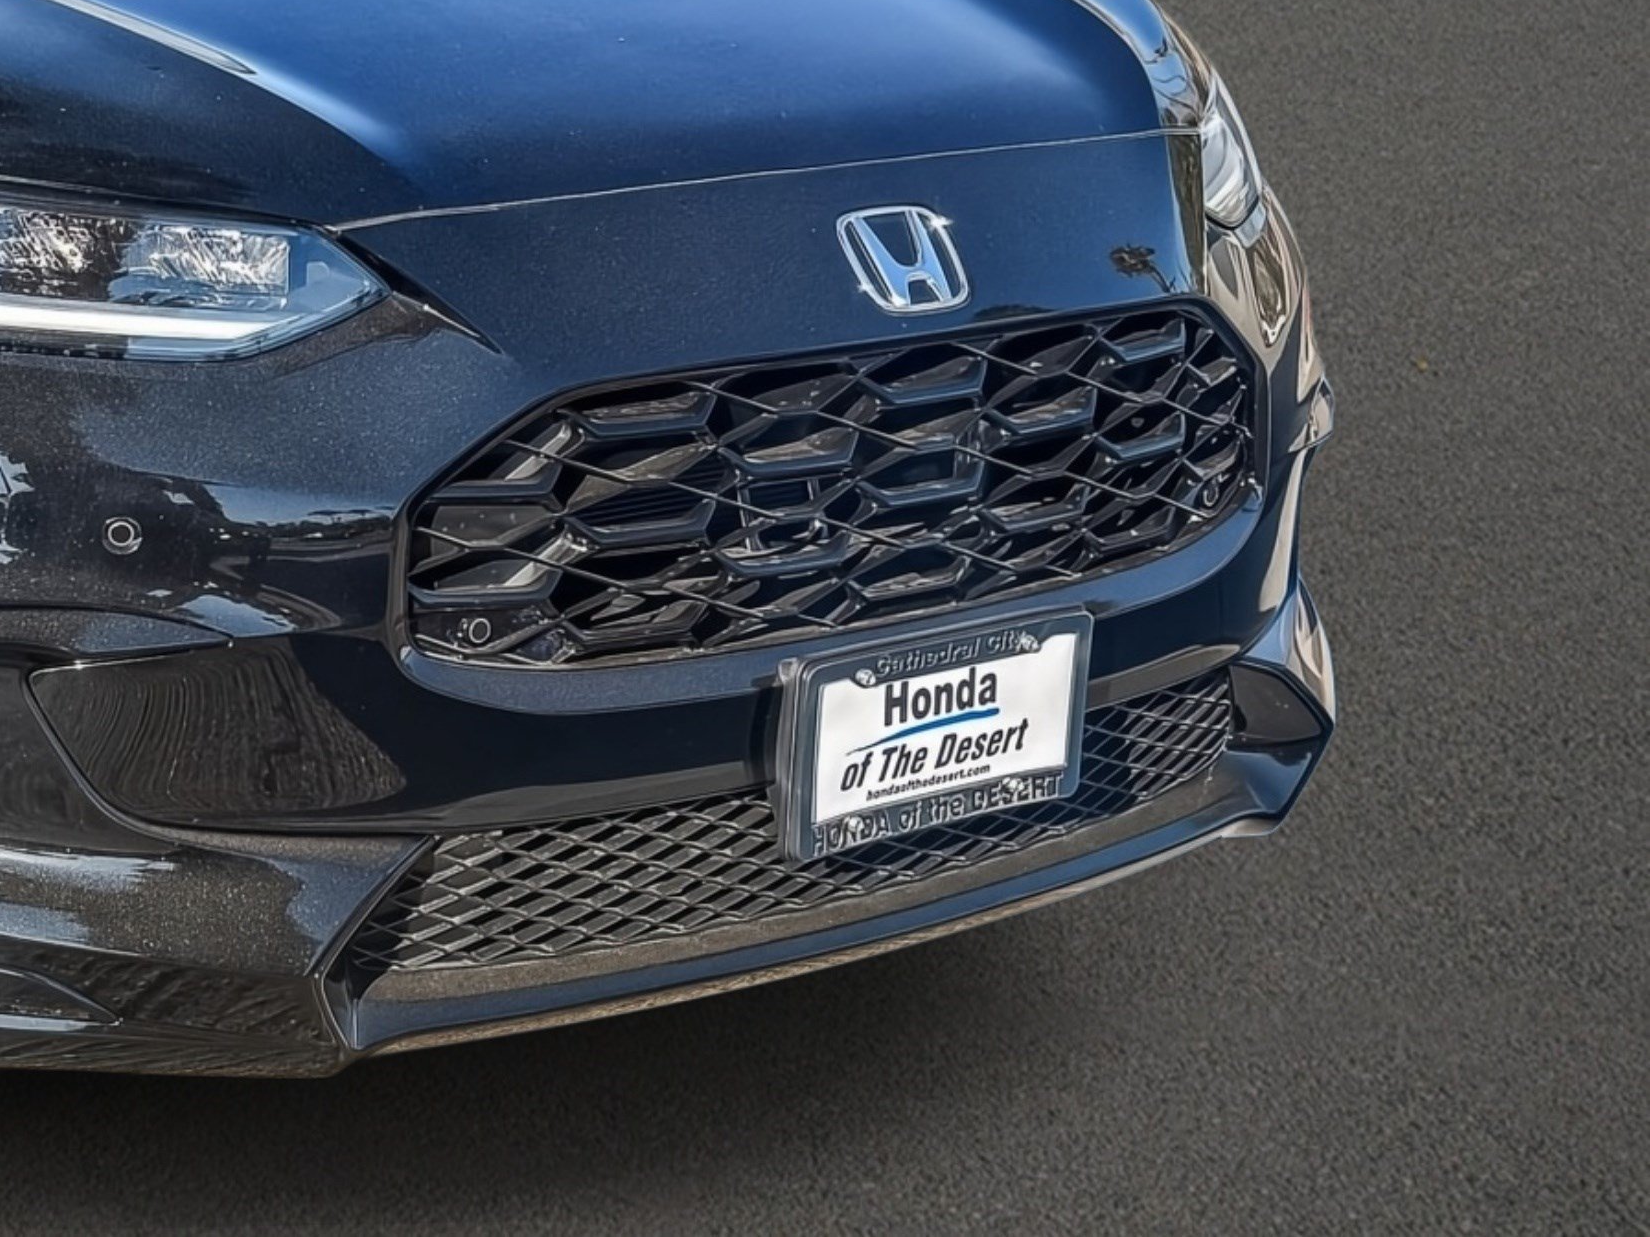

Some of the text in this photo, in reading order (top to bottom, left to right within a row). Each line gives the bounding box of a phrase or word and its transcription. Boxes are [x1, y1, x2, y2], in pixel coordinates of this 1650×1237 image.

[883, 666, 998, 727] Honda
[839, 717, 1029, 792] of The Desert
[865, 761, 991, 802] hondaofthedesert.com
